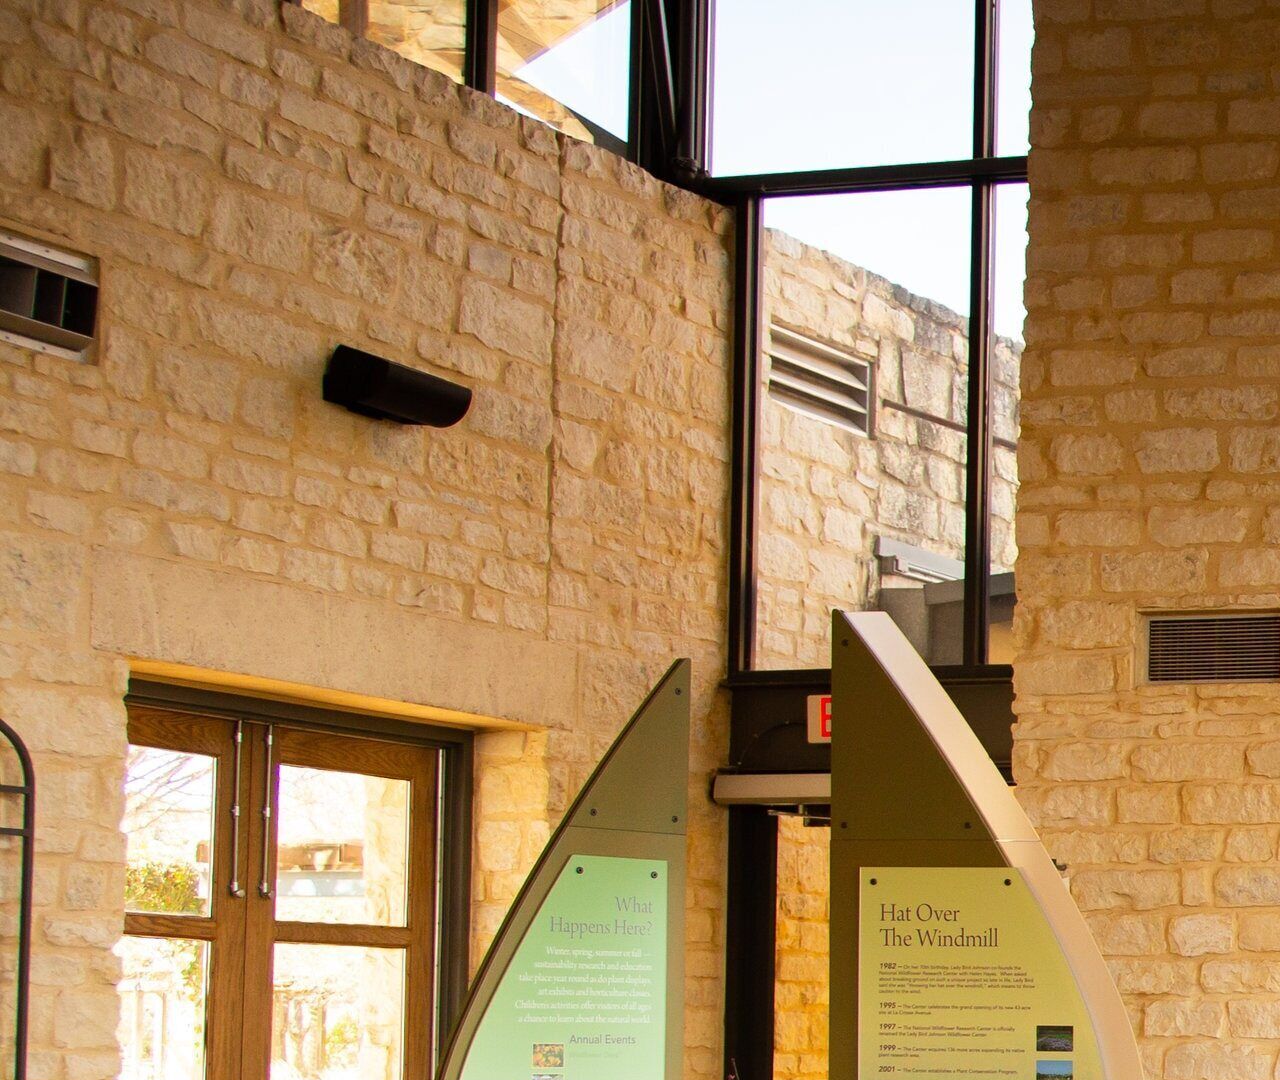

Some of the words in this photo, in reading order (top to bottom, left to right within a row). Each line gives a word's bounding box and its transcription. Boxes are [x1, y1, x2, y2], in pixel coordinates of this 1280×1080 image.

[615, 896, 653, 914] What
[880, 903, 911, 922] Hat
[916, 903, 960, 922] Over
[550, 916, 611, 939] Happens
[614, 919, 653, 936] Here?
[880, 928, 912, 947] The
[916, 927, 999, 947] Windmill
[570, 1035, 602, 1045] Annual
[605, 1035, 636, 1045] Events
